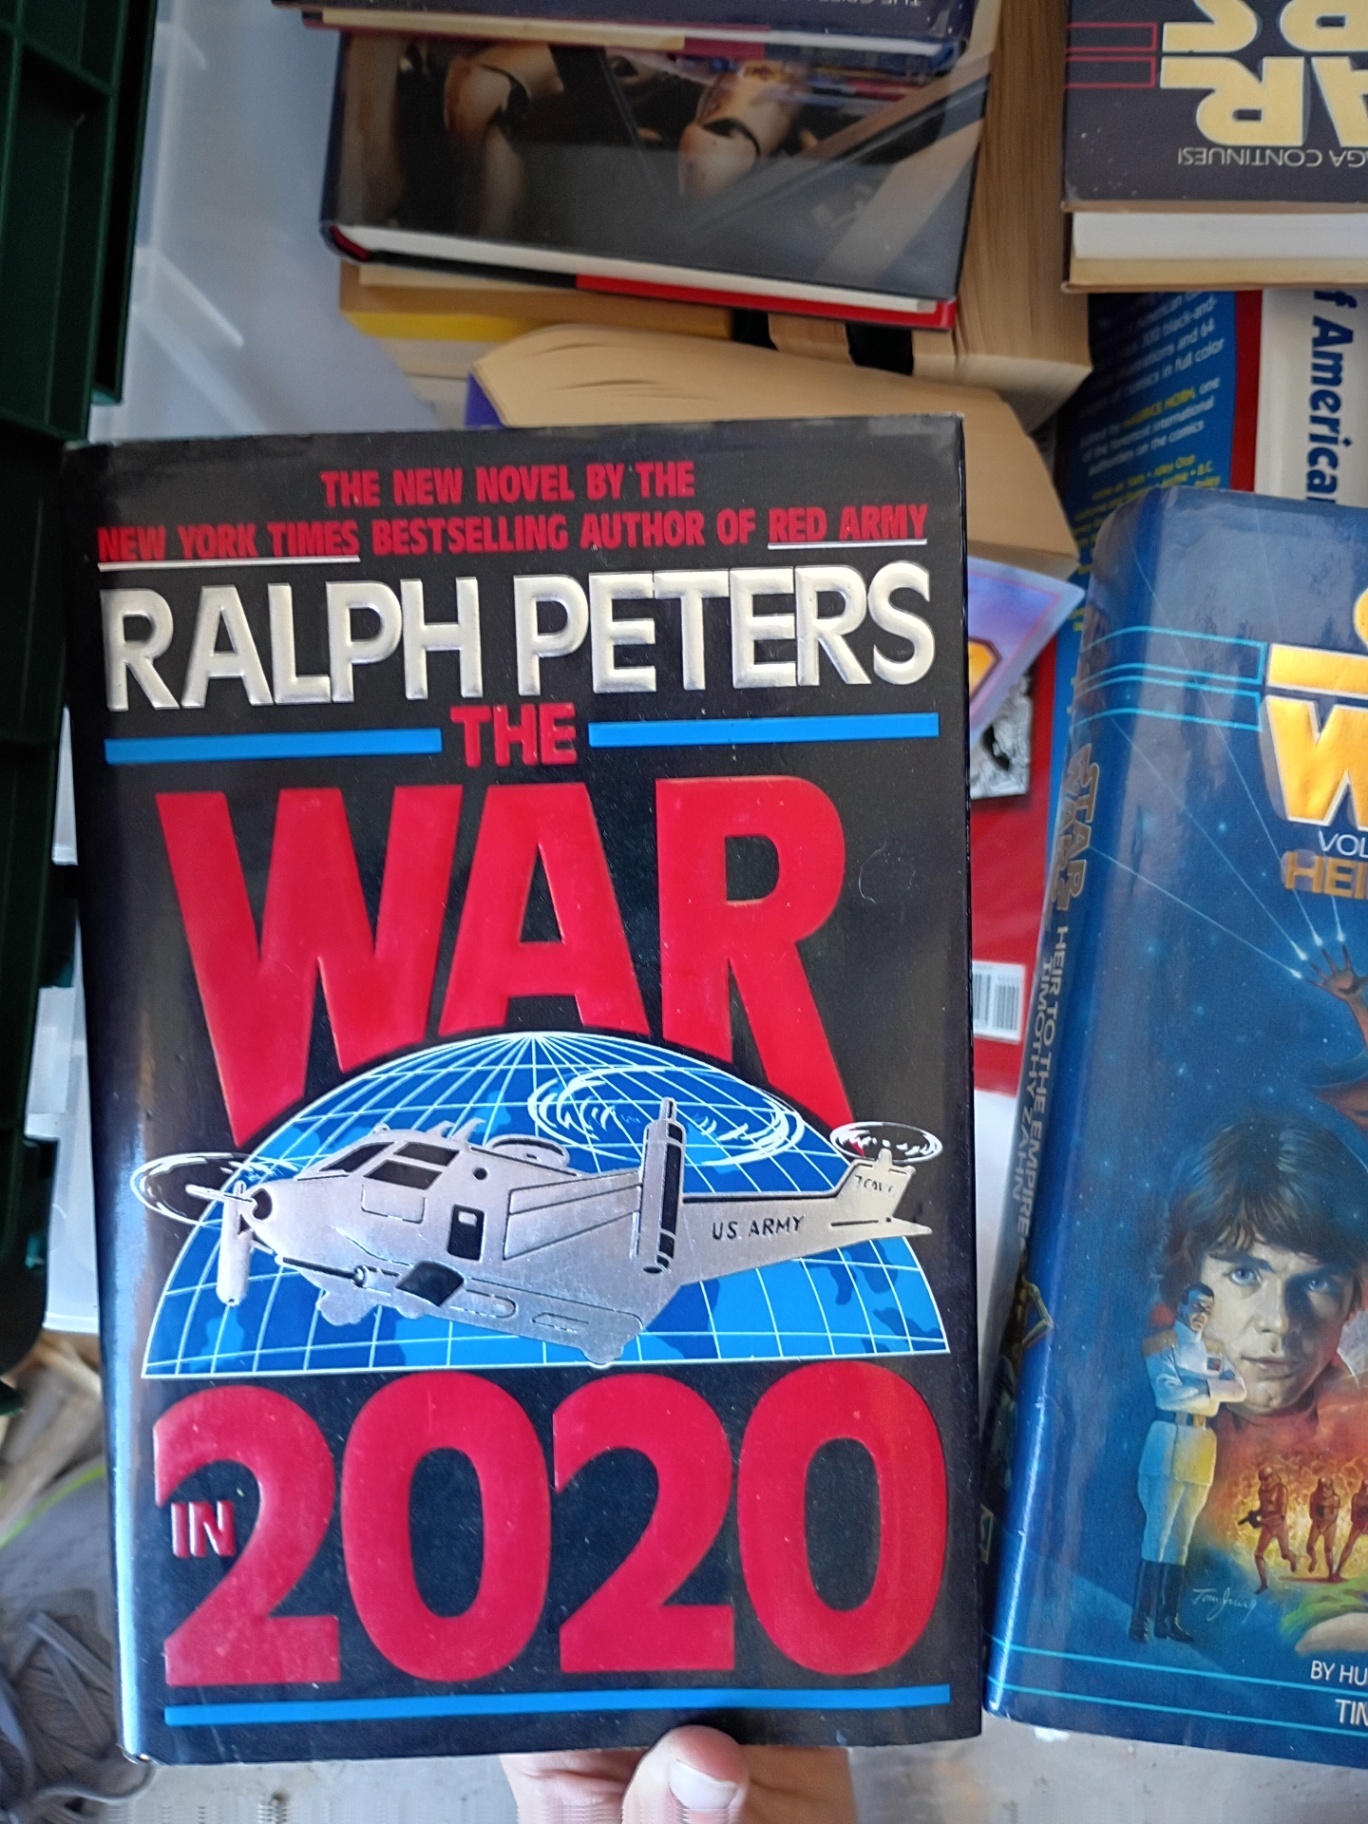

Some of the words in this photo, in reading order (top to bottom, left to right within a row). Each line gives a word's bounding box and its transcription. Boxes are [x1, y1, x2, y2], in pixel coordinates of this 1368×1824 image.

[1329, 149, 1368, 168] GA
[1304, 315, 1355, 504] America
[320, 469, 381, 508] THE
[392, 467, 463, 506] NEW
[476, 464, 575, 504] NOVEL
[586, 461, 625, 499] BY
[635, 460, 695, 498] THE
[97, 525, 166, 562] NEW
[177, 522, 259, 560] YORK
[267, 519, 360, 557] TIMES
[371, 511, 569, 556] BESTSELLING
[580, 509, 705, 550] AUTHOR
[717, 508, 757, 545] OF
[769, 505, 828, 543] RED
[838, 503, 929, 539] ARMY
[100, 576, 482, 712] RALPH
[513, 559, 936, 694] PETERS
[450, 702, 578, 769] THE
[156, 775, 855, 1148] WAR
[1047, 925, 1070, 997] HEIR
[1025, 955, 1054, 1100] TIMOTHY
[1042, 1000, 1058, 1048] TO
[1032, 1050, 1053, 1113] THE
[1012, 1105, 1033, 1201] ZAHN
[1016, 1119, 1043, 1237] EMPIRE
[711, 1222, 738, 1241] US
[748, 1215, 805, 1237] ARMY
[151, 1359, 949, 1687] 2020
[170, 1500, 237, 1558] IN
[1310, 1659, 1335, 1681] BY
